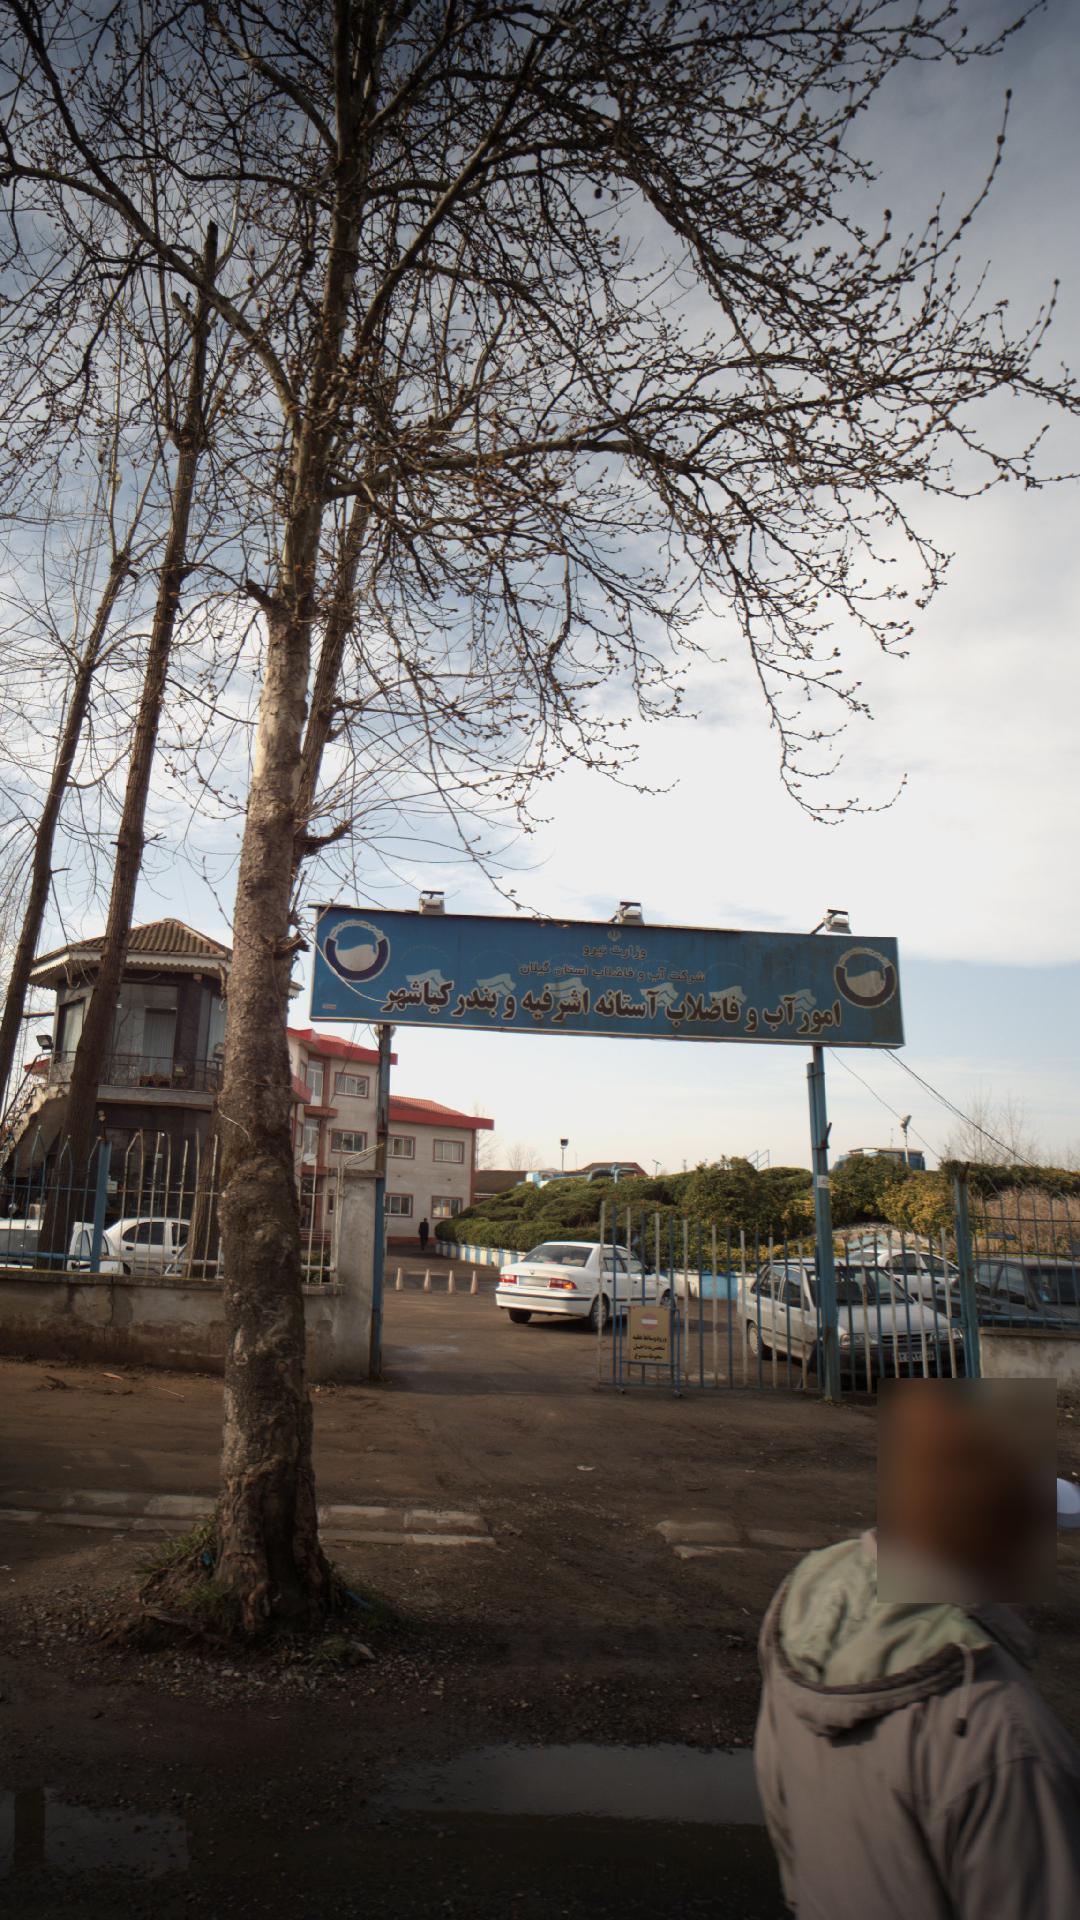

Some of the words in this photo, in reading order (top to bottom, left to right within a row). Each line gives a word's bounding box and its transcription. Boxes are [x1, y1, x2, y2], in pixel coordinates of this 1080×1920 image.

[583, 943, 608, 959] نیرو
[611, 944, 647, 960] وزارت
[519, 960, 550, 976] گیلان
[554, 965, 588, 977] استان
[591, 966, 635, 979] فاضلاب
[637, 970, 645, 982] و
[648, 966, 666, 983] آب
[670, 969, 705, 984] شرکت
[380, 979, 454, 1014] کیاشهر
[452, 986, 498, 1018] بندر
[502, 991, 516, 1019] و
[521, 984, 590, 1022] اشرفیه
[595, 987, 659, 1020] آستانه
[665, 992, 740, 1028] فاضلاب
[745, 1007, 758, 1032] و
[763, 996, 796, 1031] آب
[798, 1000, 841, 1034] امور
